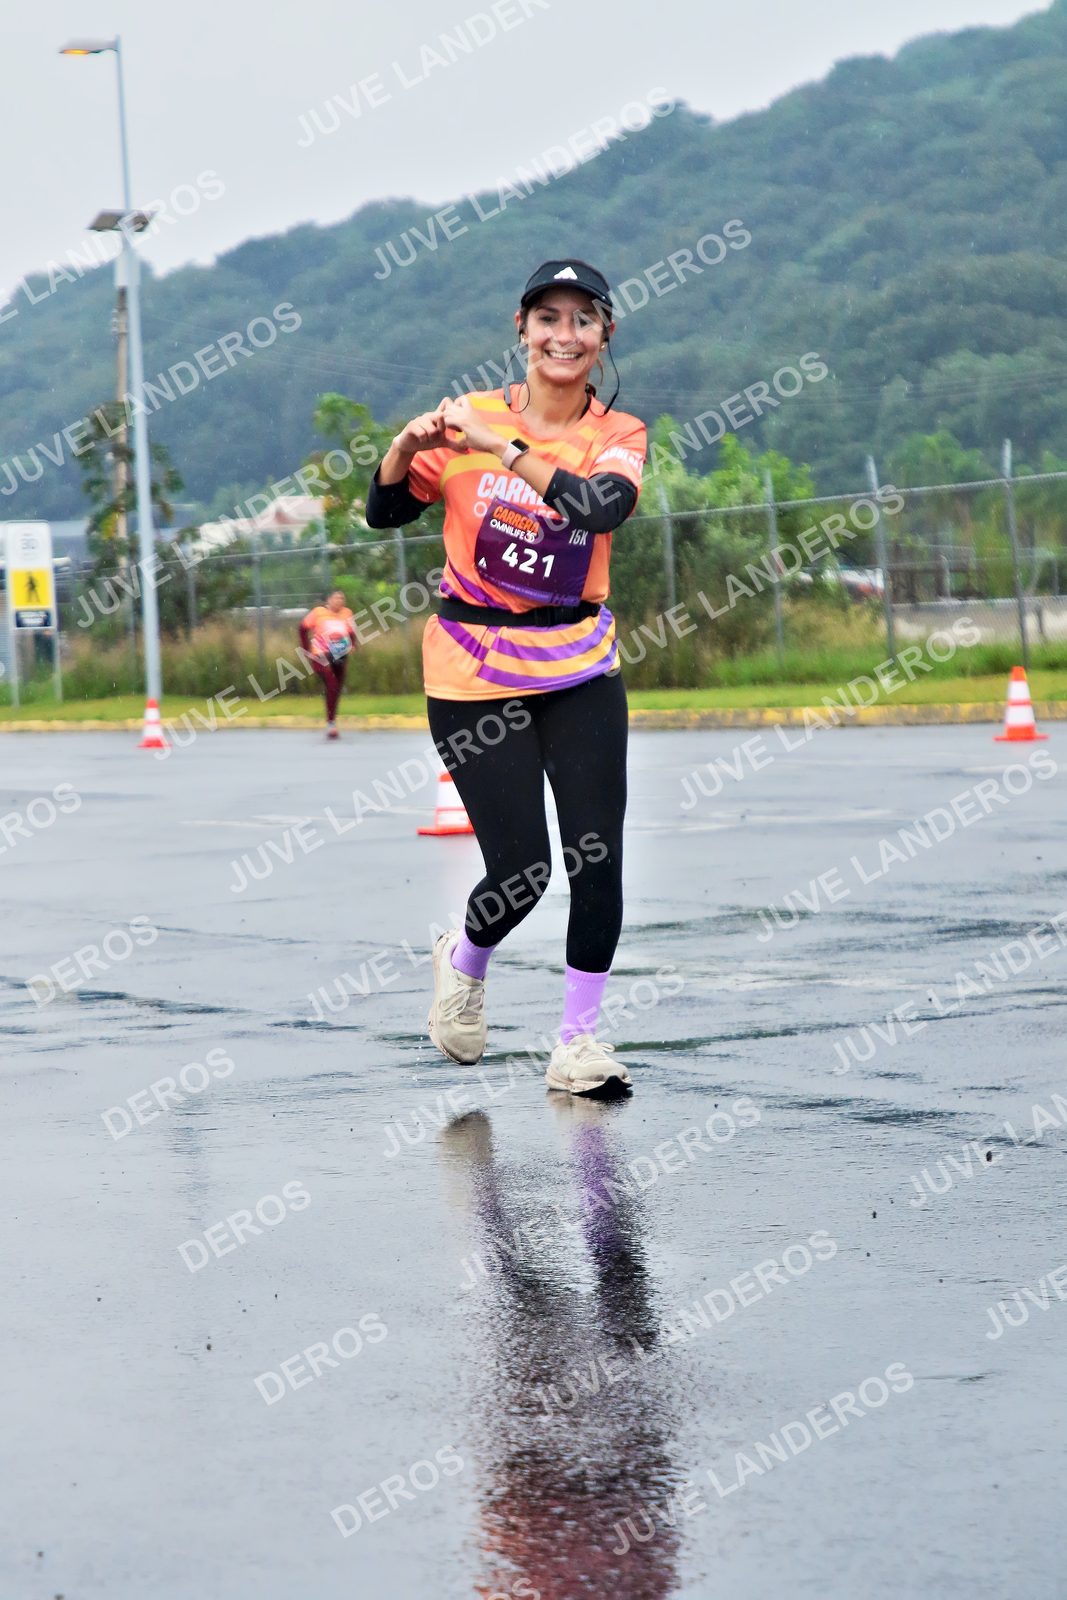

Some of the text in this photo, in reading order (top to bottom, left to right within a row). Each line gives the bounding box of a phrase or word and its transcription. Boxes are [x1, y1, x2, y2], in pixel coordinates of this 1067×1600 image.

[493, 505, 540, 533] CARRERA
[568, 527, 589, 546] 15K
[501, 542, 556, 578] 421
